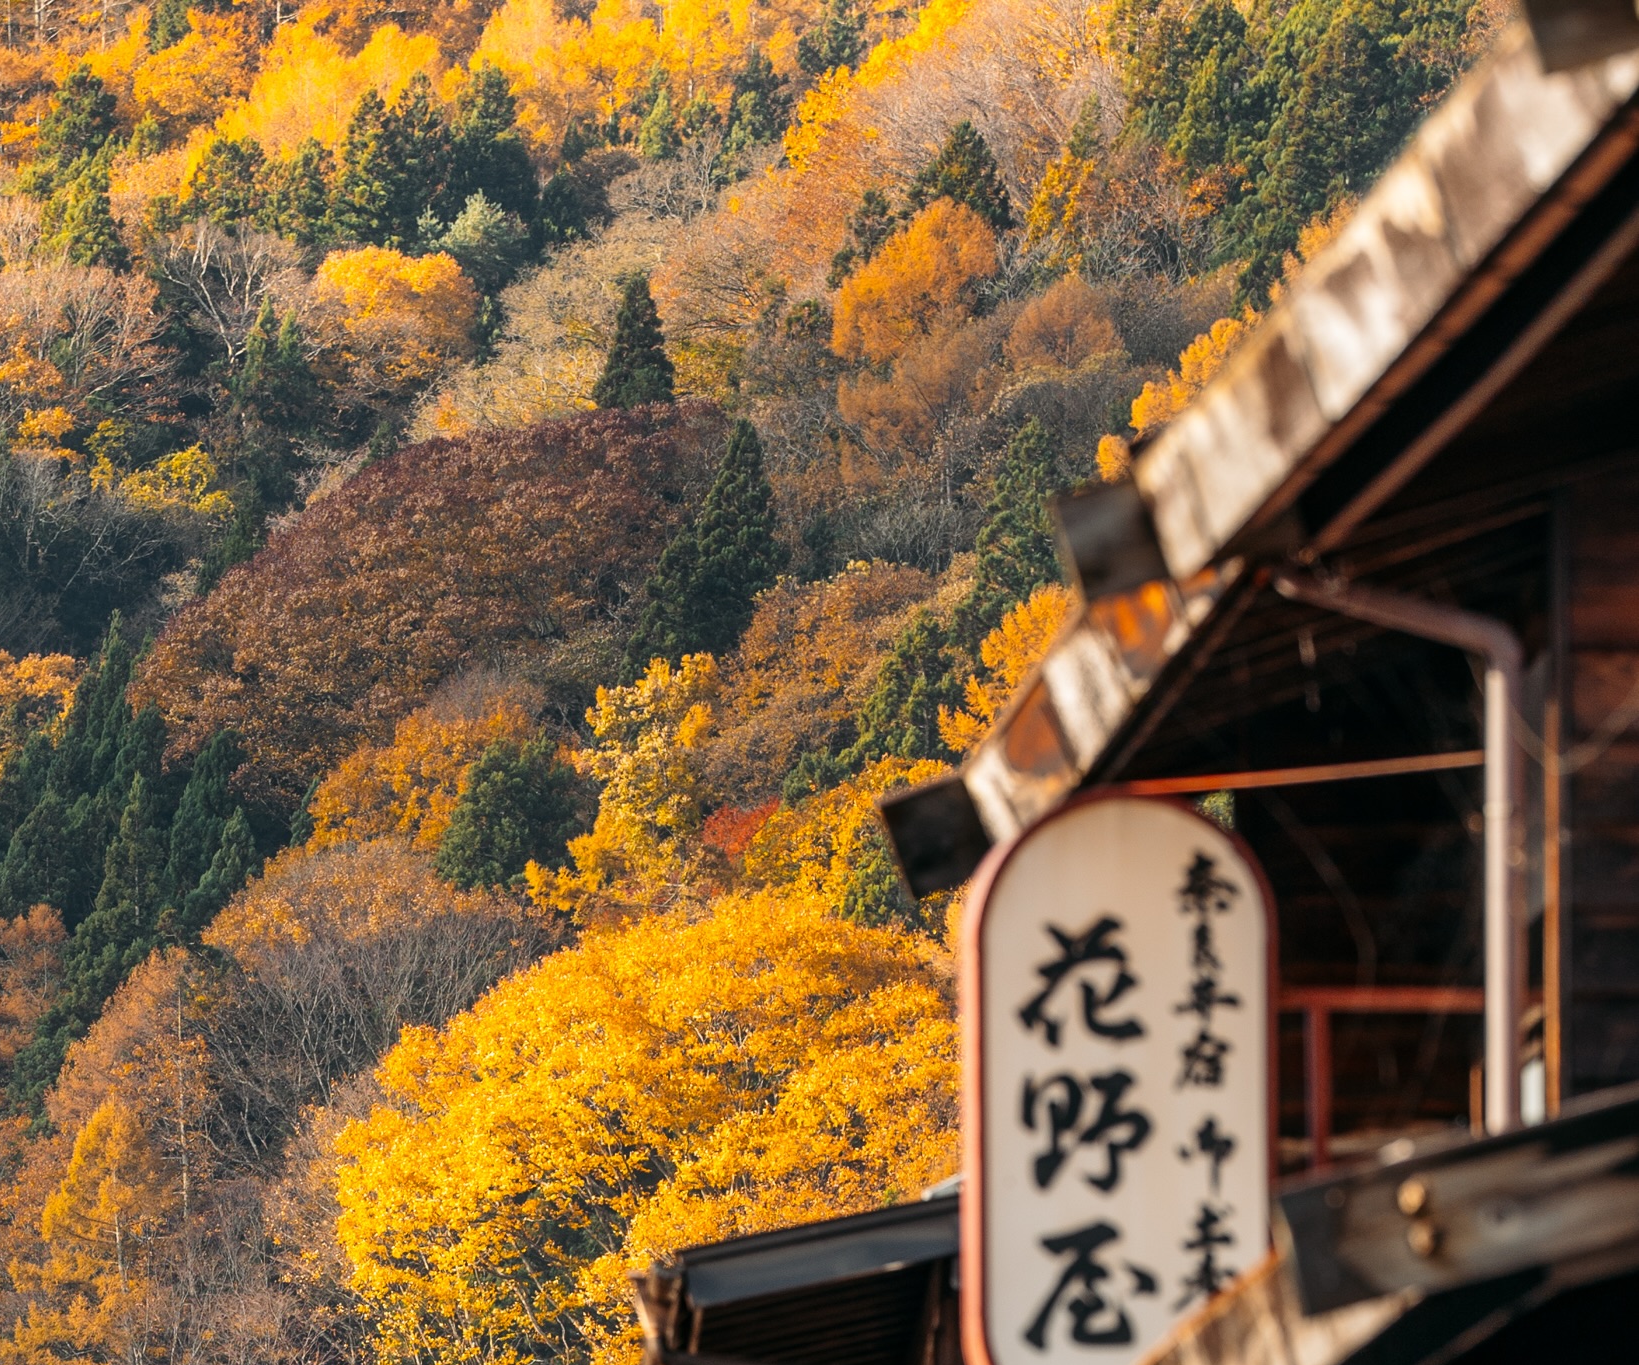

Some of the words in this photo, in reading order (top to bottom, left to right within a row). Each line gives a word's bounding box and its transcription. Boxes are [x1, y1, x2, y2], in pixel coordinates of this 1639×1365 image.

[1016, 912, 1163, 1352] 花野屋
[1172, 846, 1243, 1092] 奈良井宿
